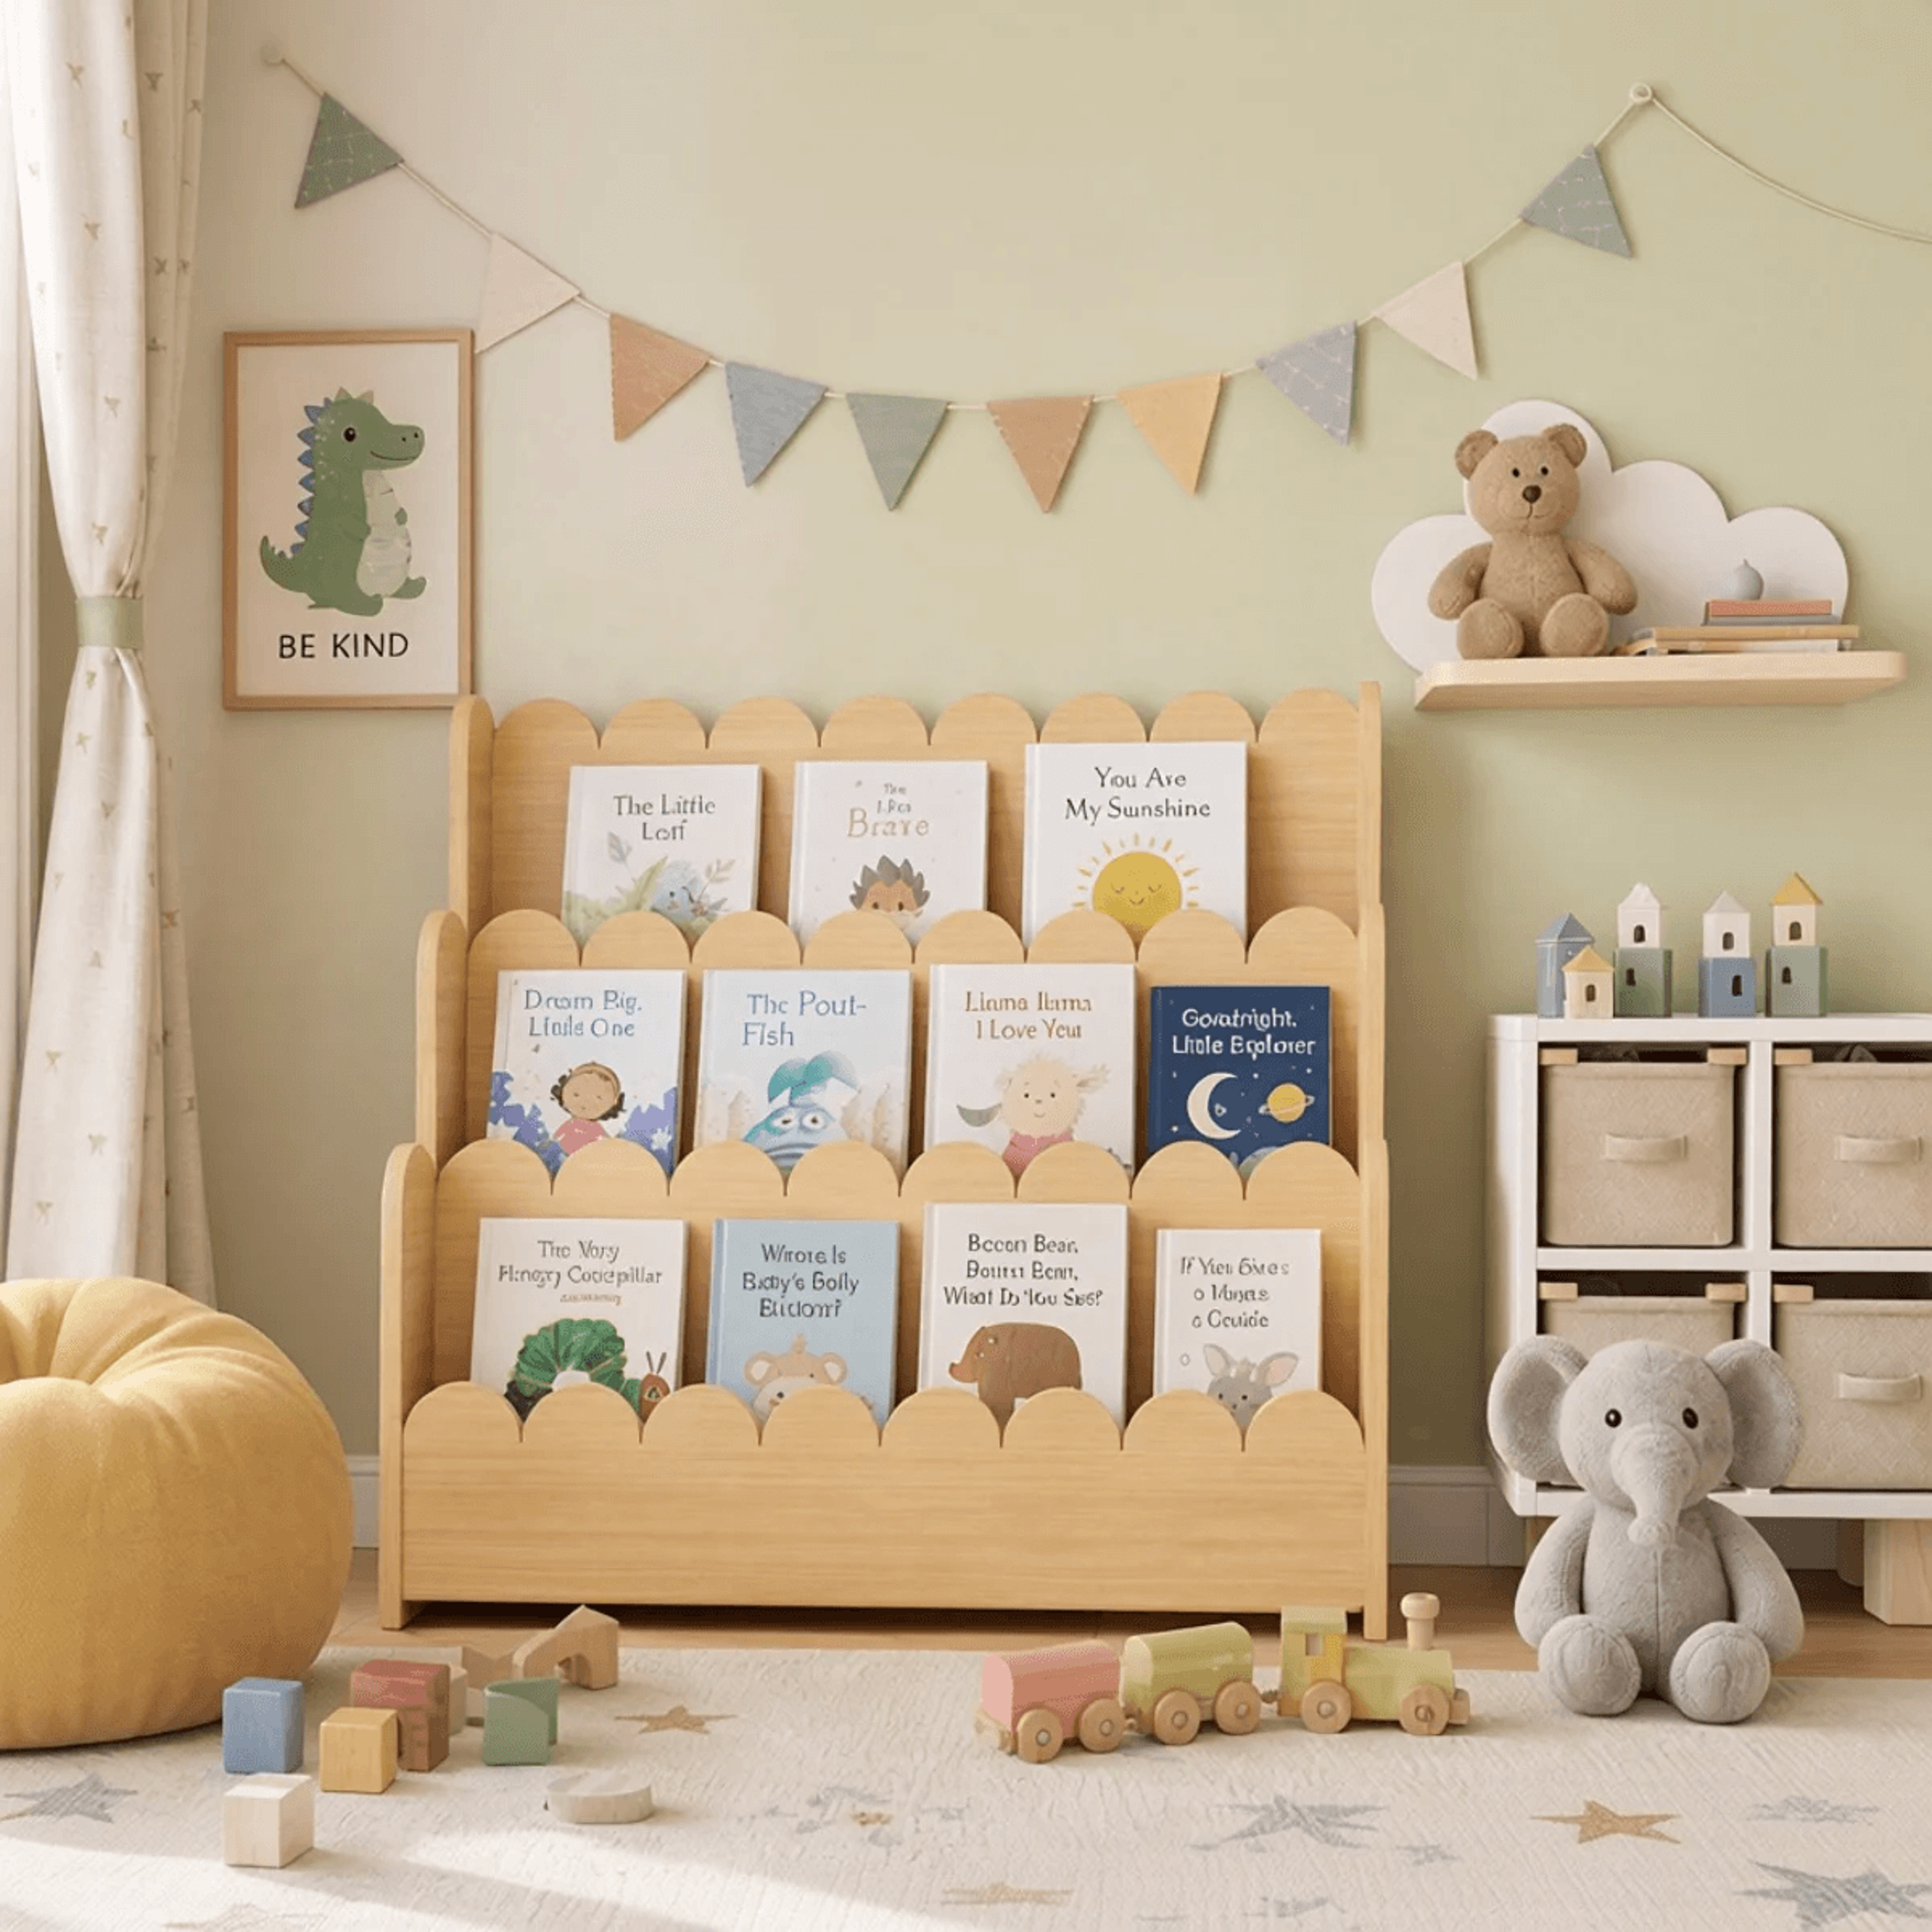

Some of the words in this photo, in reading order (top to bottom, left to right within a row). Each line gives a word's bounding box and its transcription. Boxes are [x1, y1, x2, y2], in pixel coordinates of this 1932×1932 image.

[278, 633, 316, 660] BE
[332, 631, 409, 659] KIND
[1094, 766, 1138, 789] You
[1145, 766, 1187, 789] Are
[612, 794, 654, 817] The
[1065, 797, 1102, 827] My
[1106, 795, 1211, 820] Sunshine
[590, 1017, 635, 1038] One
[989, 1018, 1038, 1040] Love
